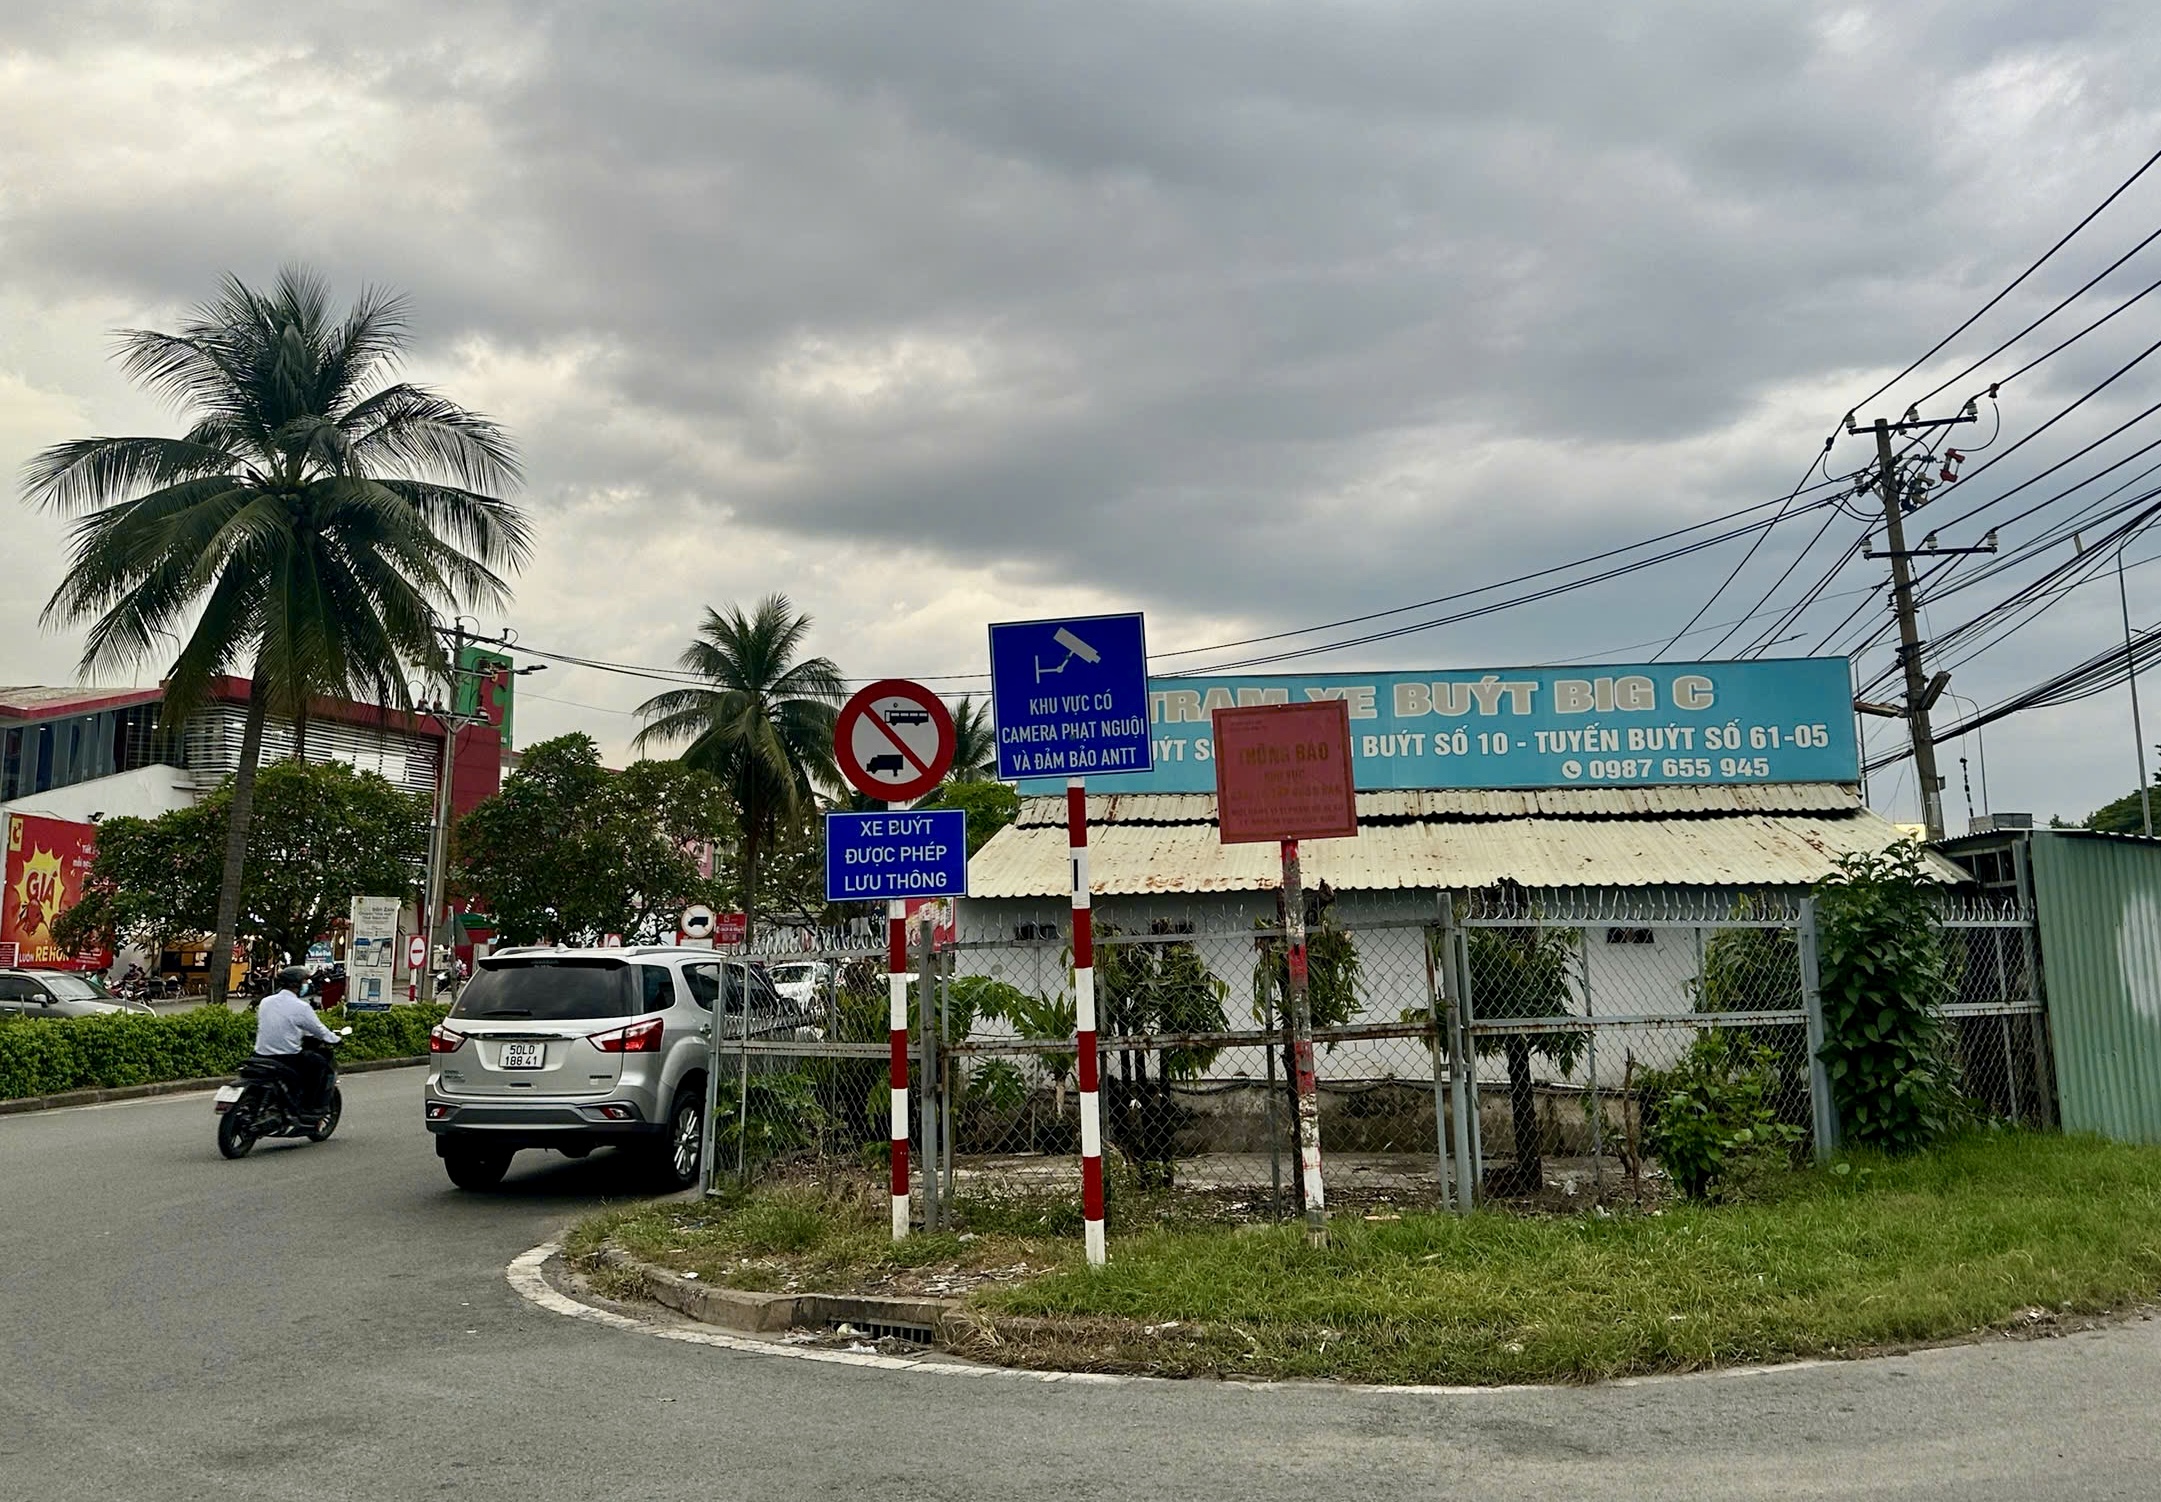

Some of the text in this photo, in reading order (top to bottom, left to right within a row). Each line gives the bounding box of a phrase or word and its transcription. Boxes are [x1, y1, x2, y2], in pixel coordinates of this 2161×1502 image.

[1029, 688, 1113, 716] KHU VỰC CÓ
[1393, 674, 1539, 718] BUÝT
[1553, 675, 1656, 715] BIG
[1671, 674, 1714, 711] C
[1001, 715, 1145, 744] CAMERA PHẠT NGUỘI
[1194, 737, 1216, 761] S
[1362, 729, 1426, 758] BUÝT
[1434, 724, 1470, 756] SỐ
[1477, 732, 1509, 756] 10
[1534, 721, 1620, 754] TUYẾN
[1627, 722, 1696, 751] BUÝT
[1704, 717, 1743, 751] SỐ
[1750, 724, 1829, 749] 61-05
[1012, 745, 1136, 771] VÀ ĐẢM BẢO ANTT
[1589, 757, 1770, 779] 0987 655 945
[860, 815, 933, 837] XE BUÝT
[845, 841, 947, 867] ĐƯỢC PHÉP
[26, 870, 58, 910] GIÁ
[844, 869, 947, 892] LƯU THÔNG
